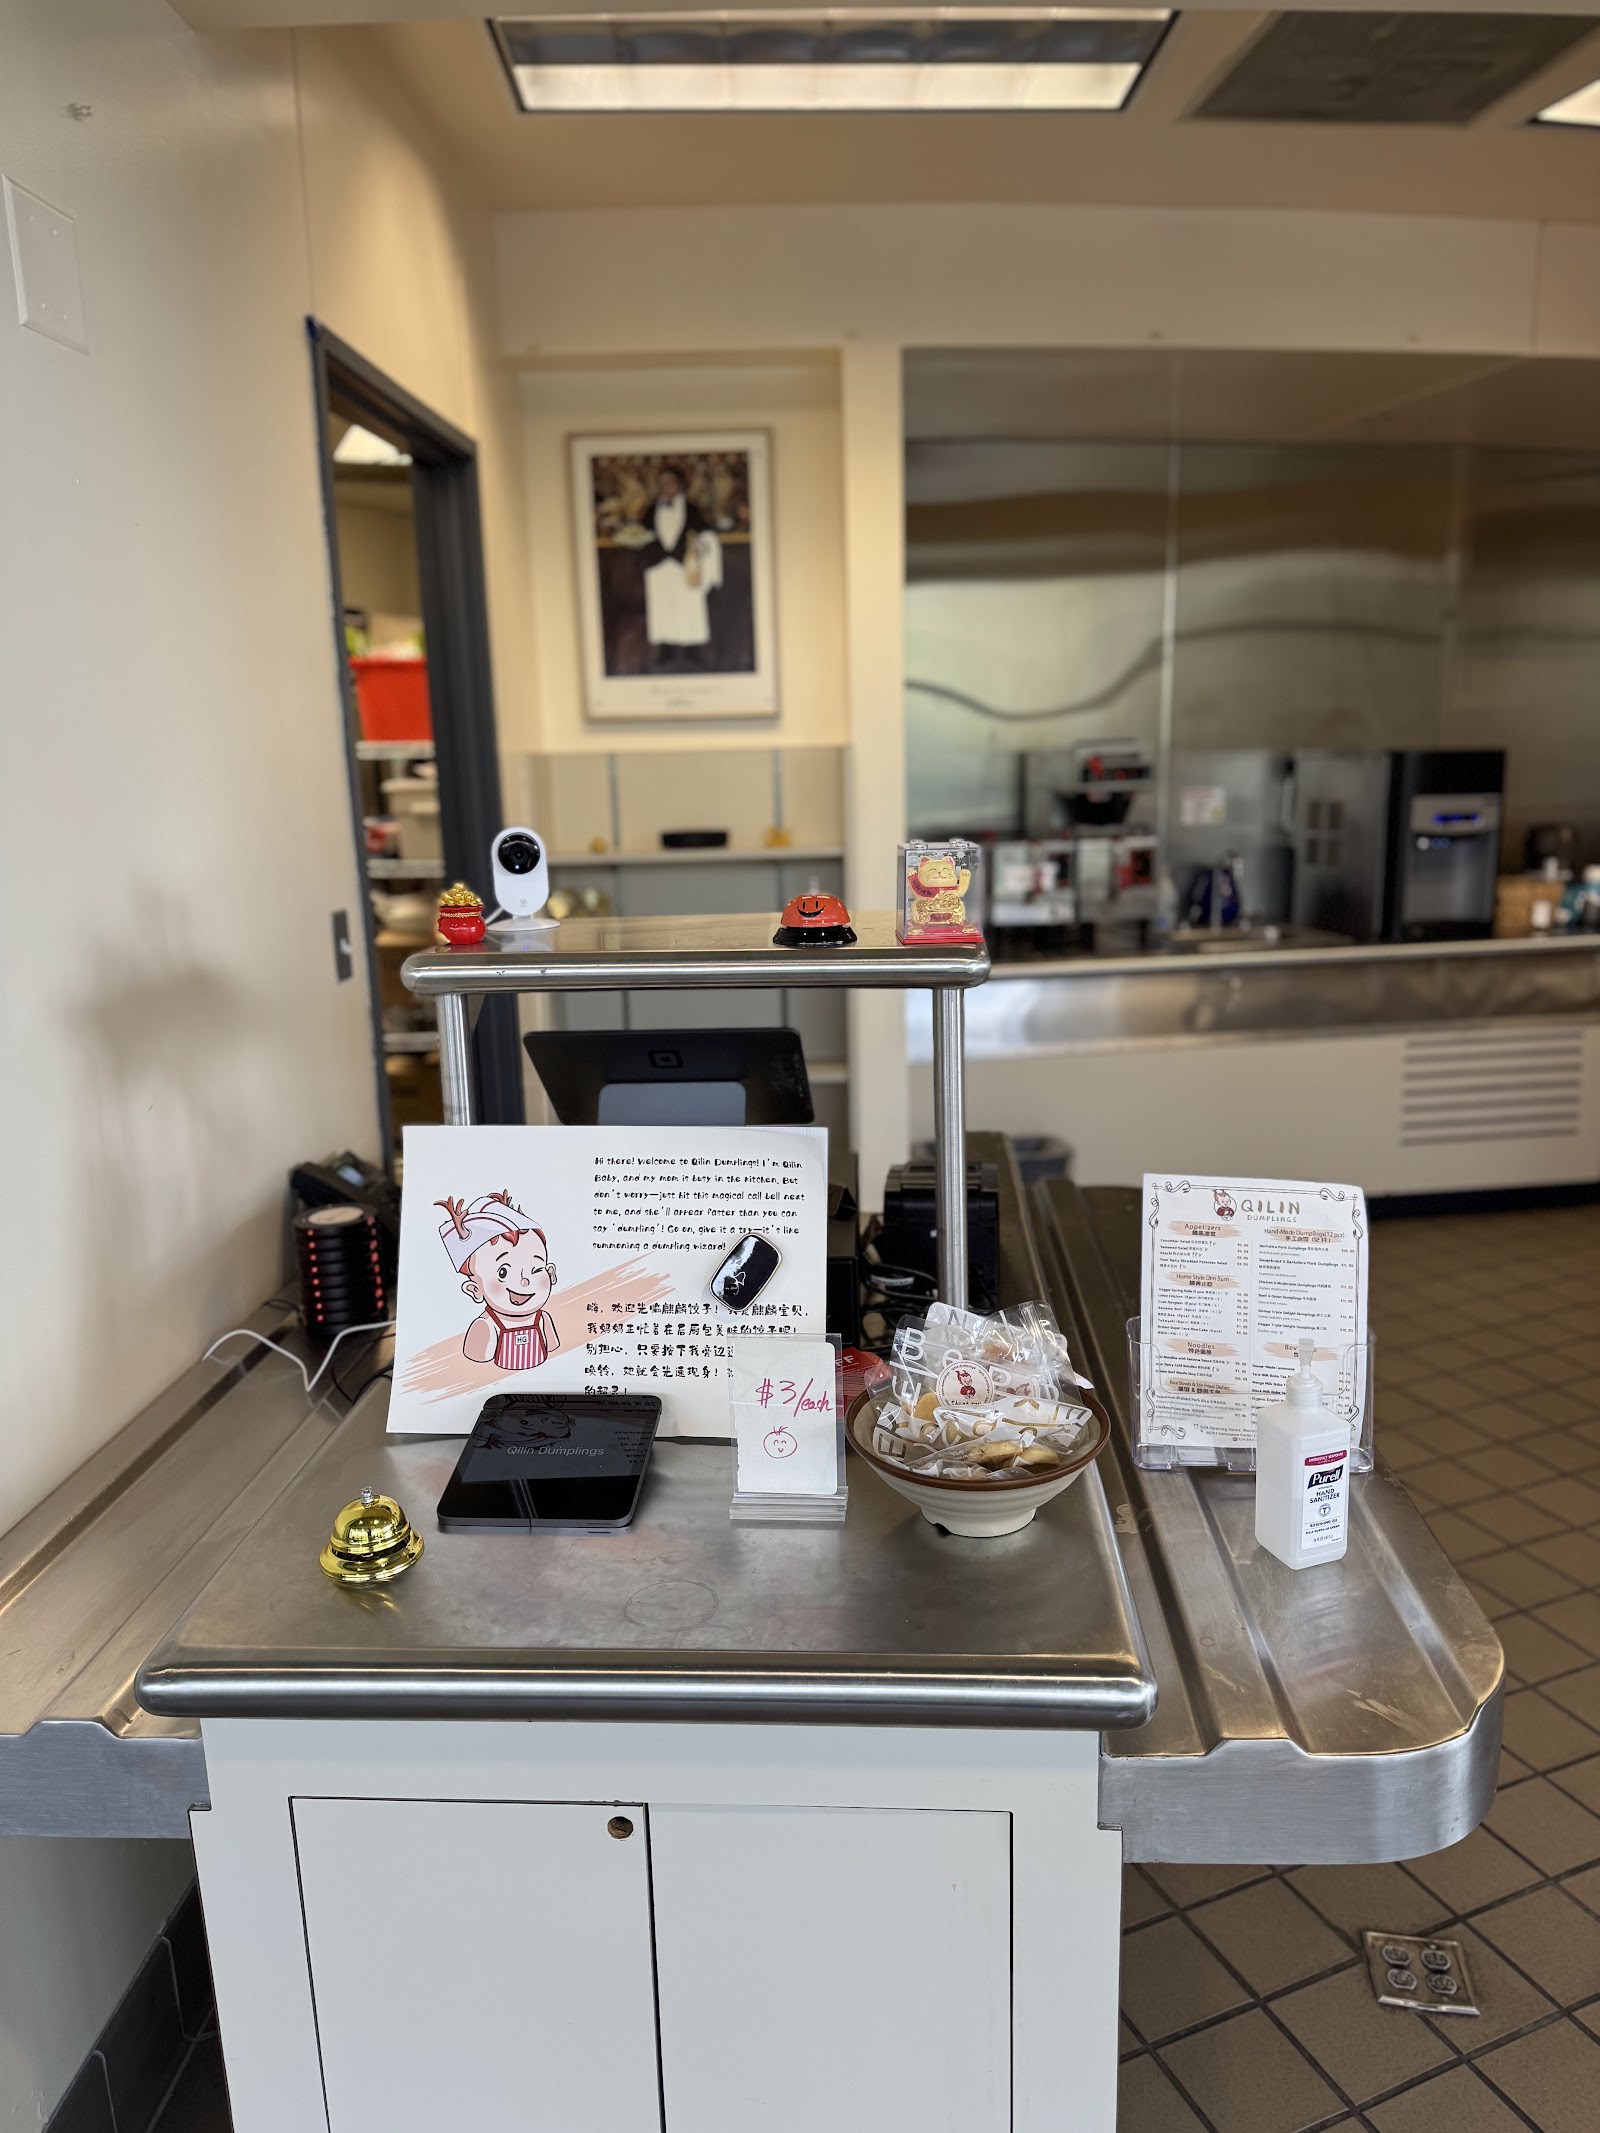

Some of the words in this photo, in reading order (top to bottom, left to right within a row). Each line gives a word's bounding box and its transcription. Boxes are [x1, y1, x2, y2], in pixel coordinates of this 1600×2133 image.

[595, 1157, 603, 1165] Hi
[607, 1157, 634, 1165] there!
[691, 1157, 711, 1165] Qilin
[715, 1158, 759, 1168] Dumplings!
[782, 1160, 802, 1168] Qilin
[595, 1174, 620, 1183] Baby,
[623, 1173, 640, 1182] and
[693, 1175, 711, 1183] busy
[712, 1191, 744, 1201] magical
[748, 1192, 761, 1200] call
[766, 1192, 780, 1200] bell
[594, 1208, 602, 1216] to
[625, 1207, 641, 1215] and
[708, 1208, 736, 1216] faster
[1242, 1199, 1300, 1215] QILIN
[1247, 1214, 1297, 1222] DUMPLINGS
[593, 1225, 607, 1233] say
[667, 1225, 679, 1233] Go
[682, 1226, 695, 1234] on,
[699, 1225, 716, 1235] give
[784, 1226, 799, 1234] like
[593, 1242, 640, 1252] summoning
[652, 1241, 690, 1252] dumpling
[694, 1242, 726, 1250] wizard!
[1193, 1273, 1205, 1281] Style
[1188, 1341, 1215, 1350] Noodles
[507, 1446, 534, 1456] Qilin
[538, 1446, 604, 1457] Dumplings
[1312, 1468, 1341, 1485] Purell
[1316, 1488, 1334, 1496] HAND
[1310, 1492, 1340, 1504] SANITIZER
